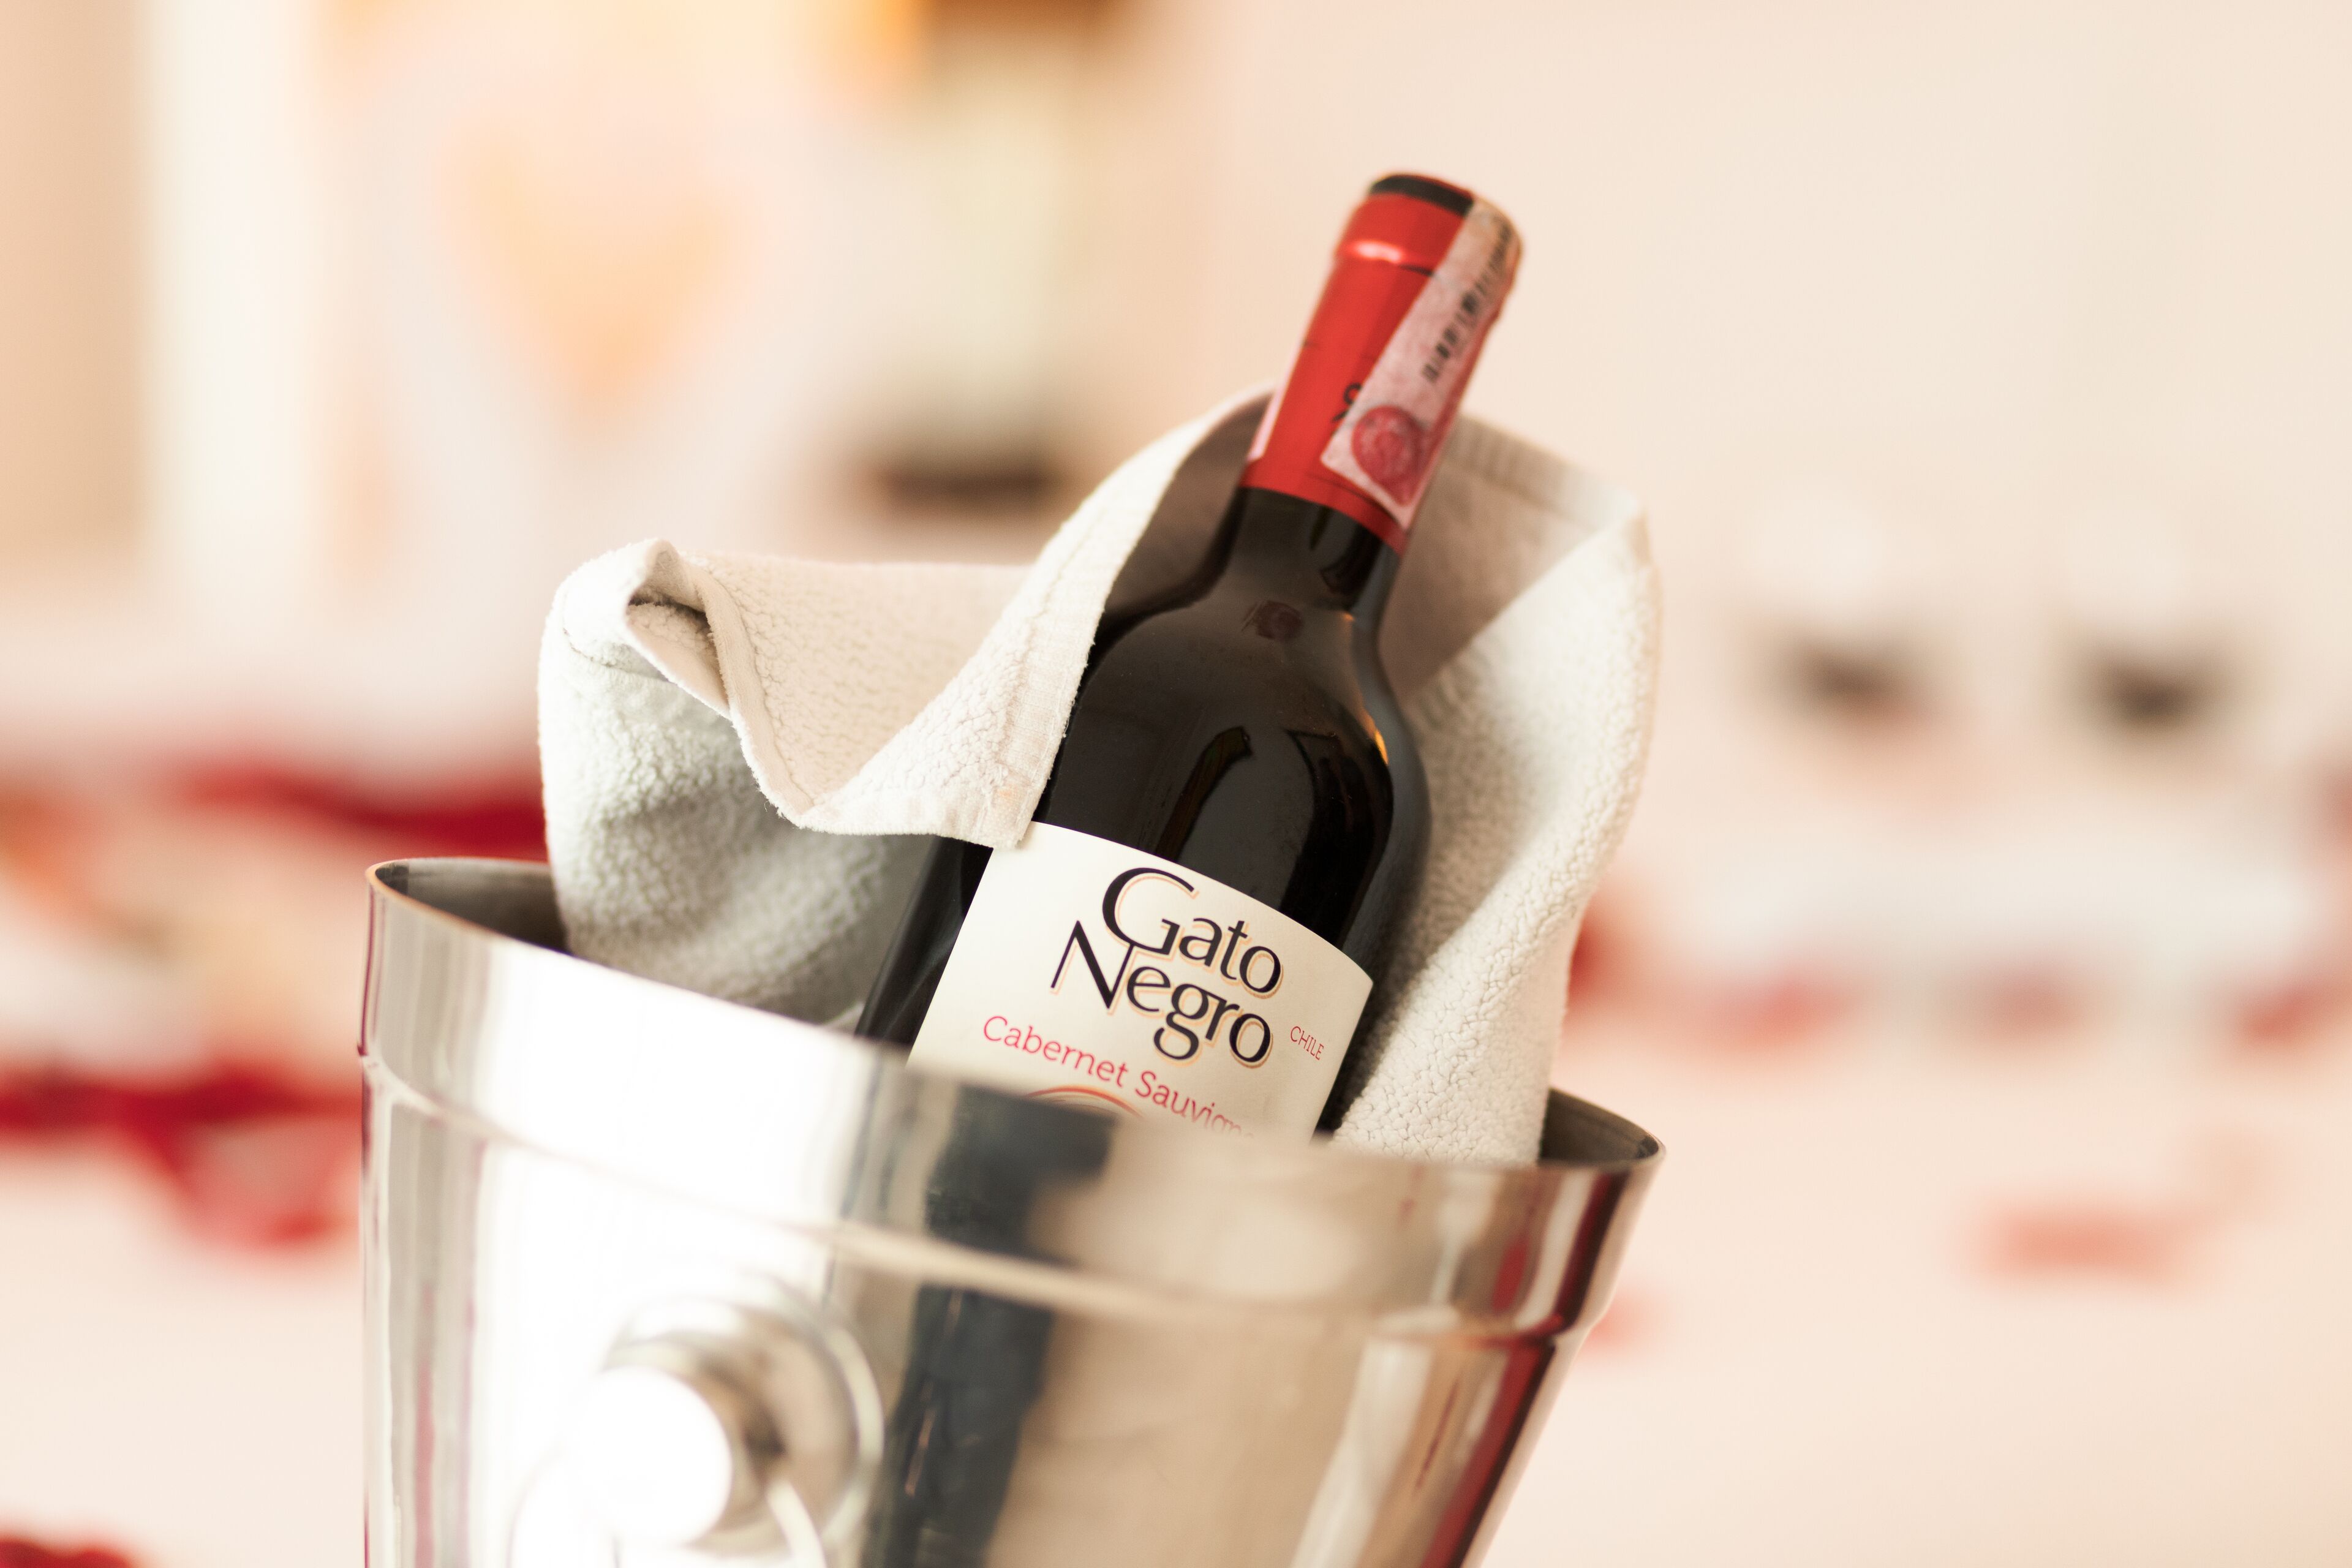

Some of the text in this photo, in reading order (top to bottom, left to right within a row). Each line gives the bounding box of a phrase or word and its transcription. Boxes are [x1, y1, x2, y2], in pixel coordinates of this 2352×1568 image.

[1050, 920, 1272, 1066] Negro
[1102, 867, 1283, 997] Gato
[983, 1016, 1254, 1138] Cabernet Sauvi
[1290, 1025, 1324, 1061] CHILE
